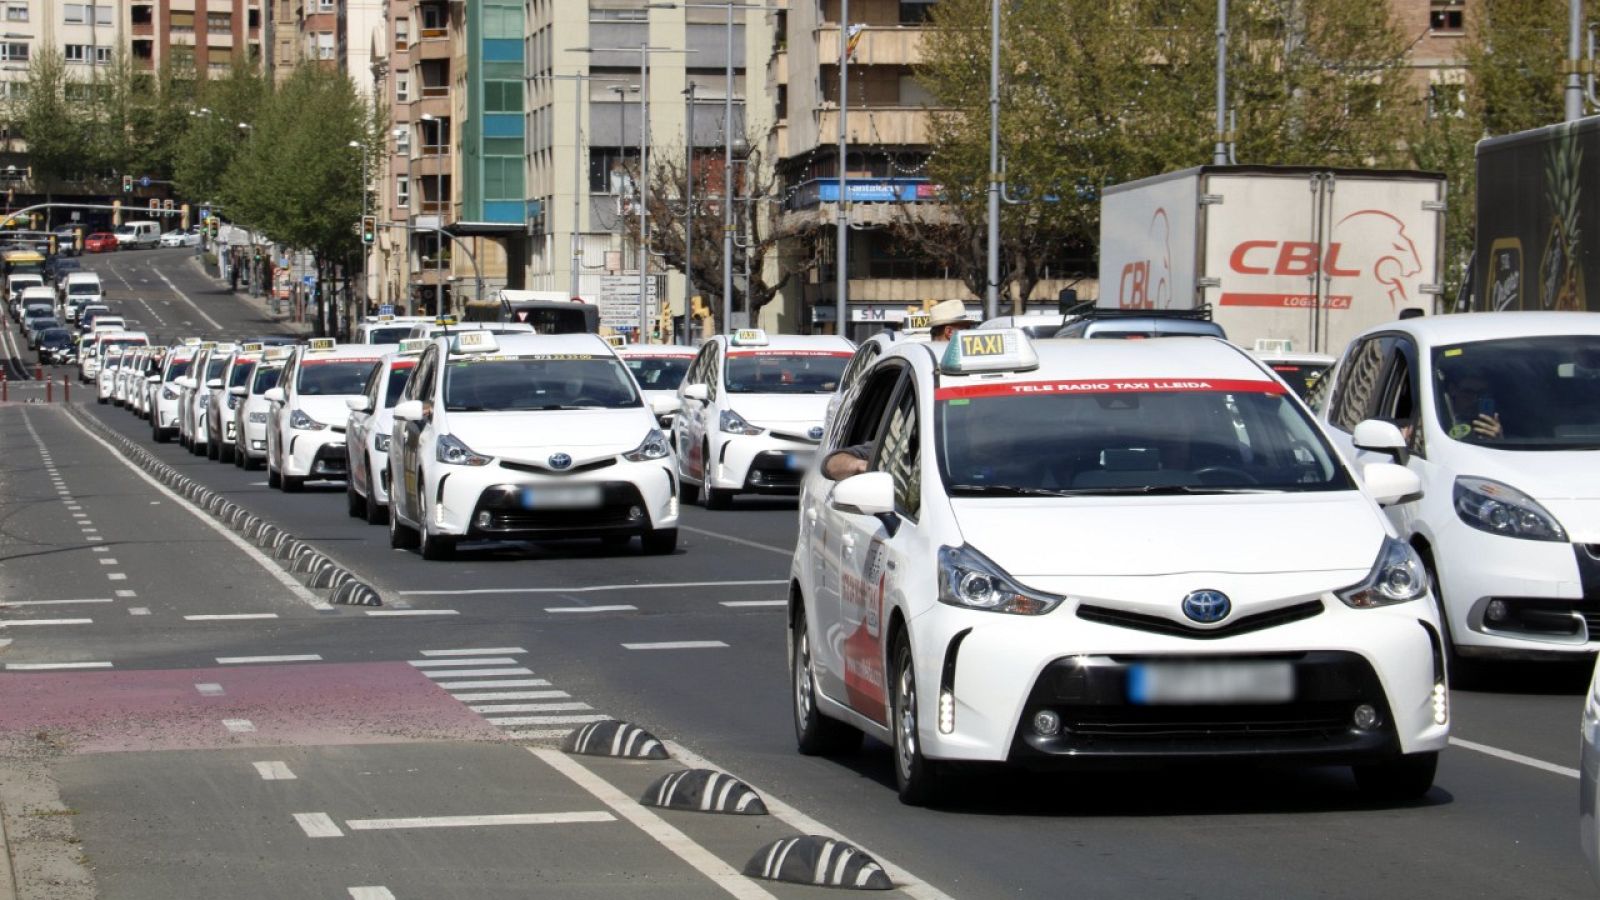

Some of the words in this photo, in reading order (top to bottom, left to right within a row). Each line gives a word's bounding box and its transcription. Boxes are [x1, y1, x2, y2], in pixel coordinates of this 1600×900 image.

[1229, 240, 1361, 277] CBL
[1119, 260, 1154, 310] CBL
[1283, 296, 1348, 308] LOGISICA
[911, 315, 931, 329] TAX
[462, 335, 481, 345] TAXI
[962, 334, 1003, 356] TAXI
[1058, 383, 1110, 391] RADIO
